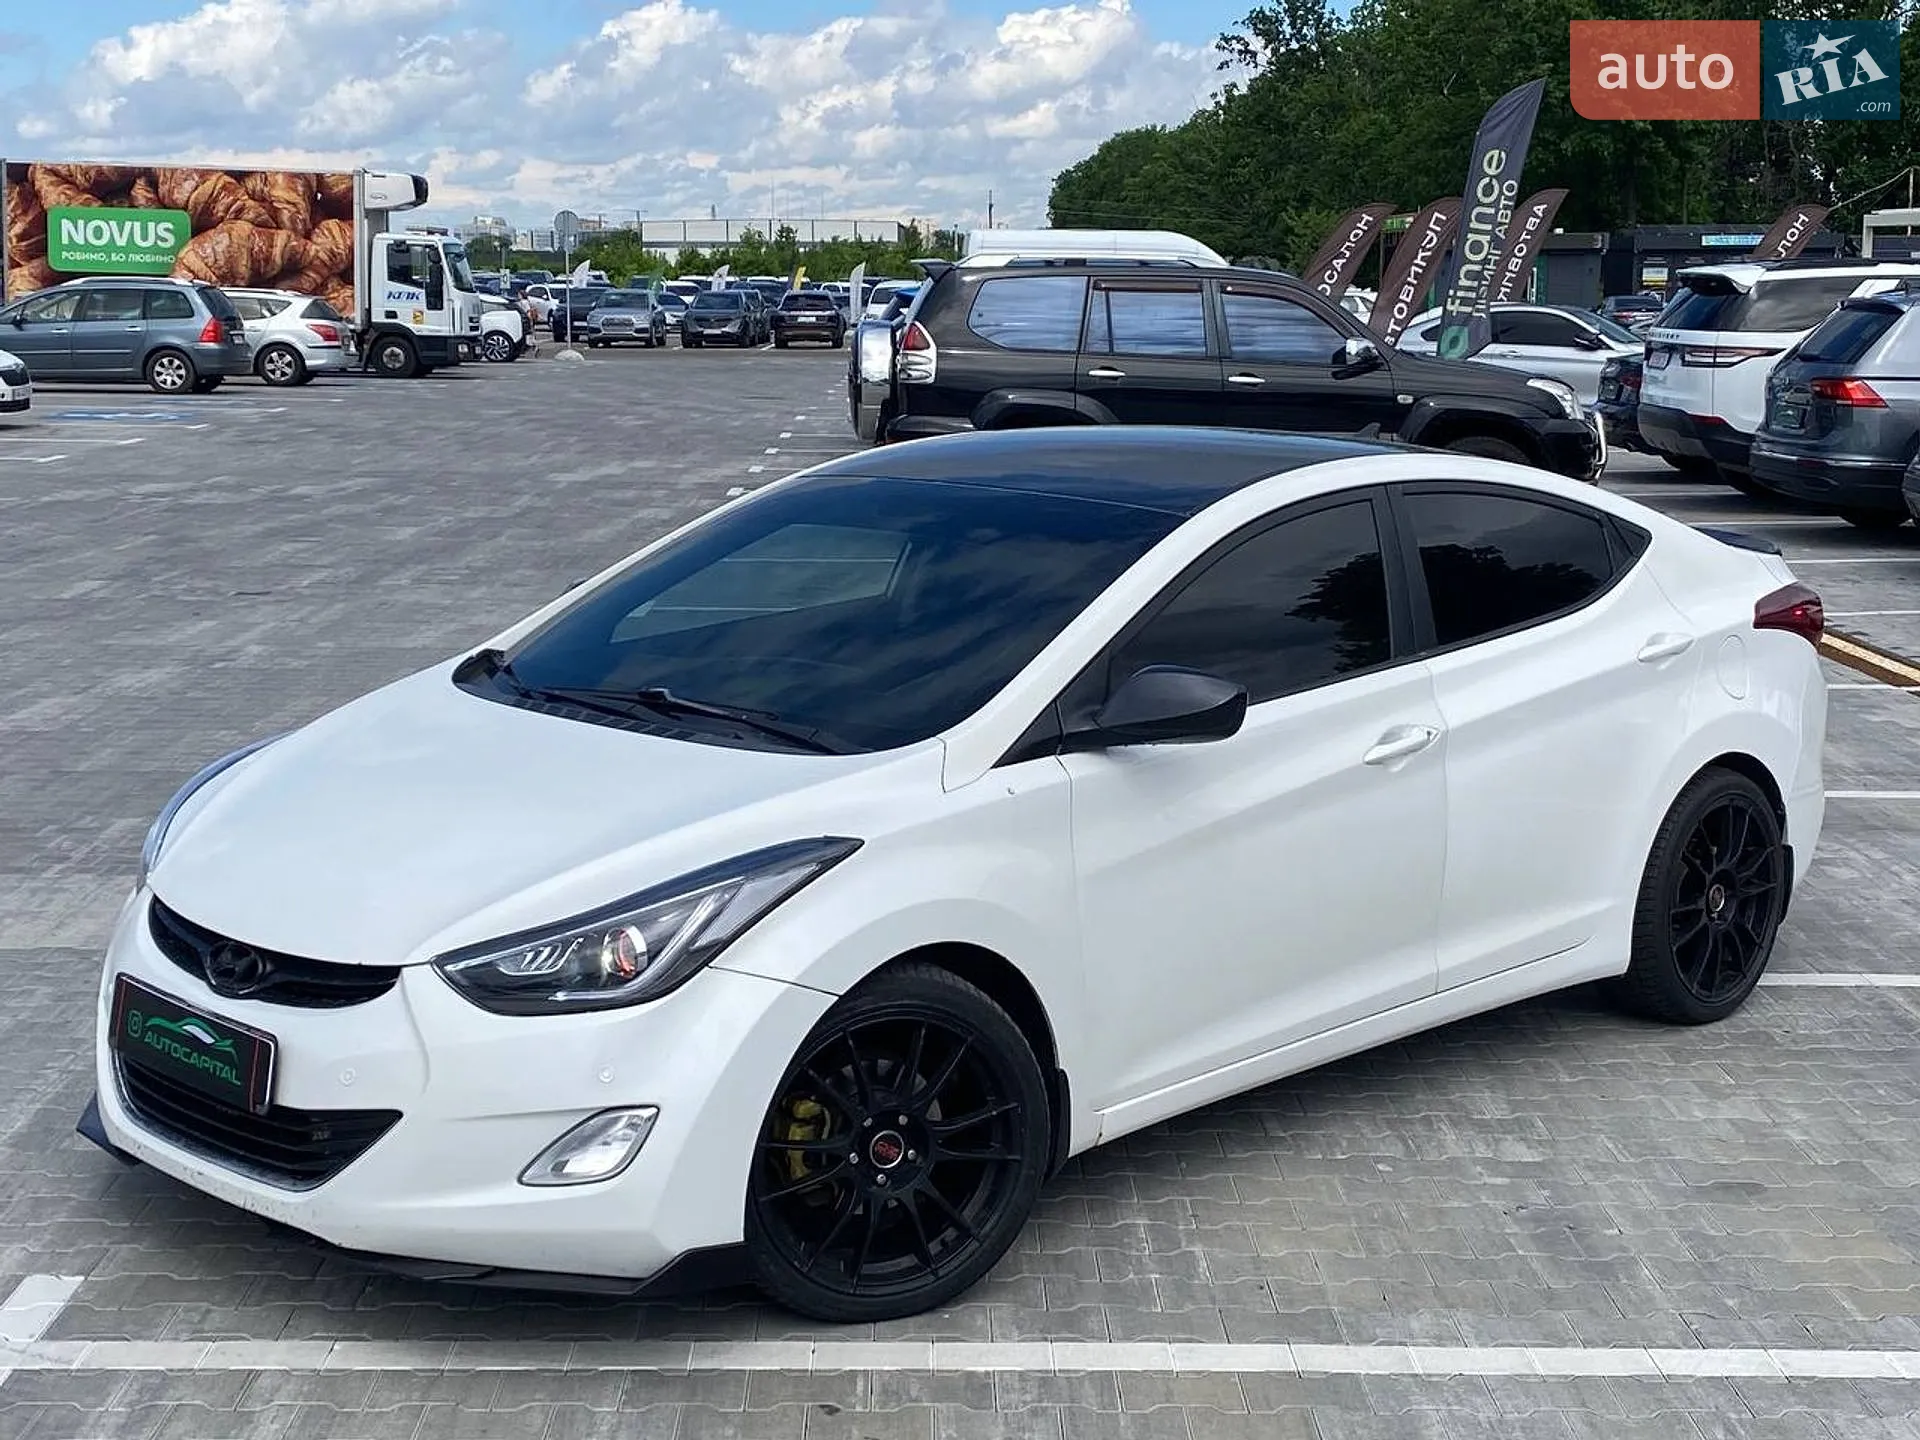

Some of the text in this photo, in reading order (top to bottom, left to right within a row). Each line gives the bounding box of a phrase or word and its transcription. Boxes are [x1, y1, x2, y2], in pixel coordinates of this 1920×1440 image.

[61, 219, 175, 248] NOVUS
[1446, 149, 1506, 317] finance
[1495, 180, 1519, 240] АВТО
[61, 251, 176, 263] РОБИМО, БО ЛЮБИМО
[144, 1030, 241, 1085] AUTOCAPITAL
